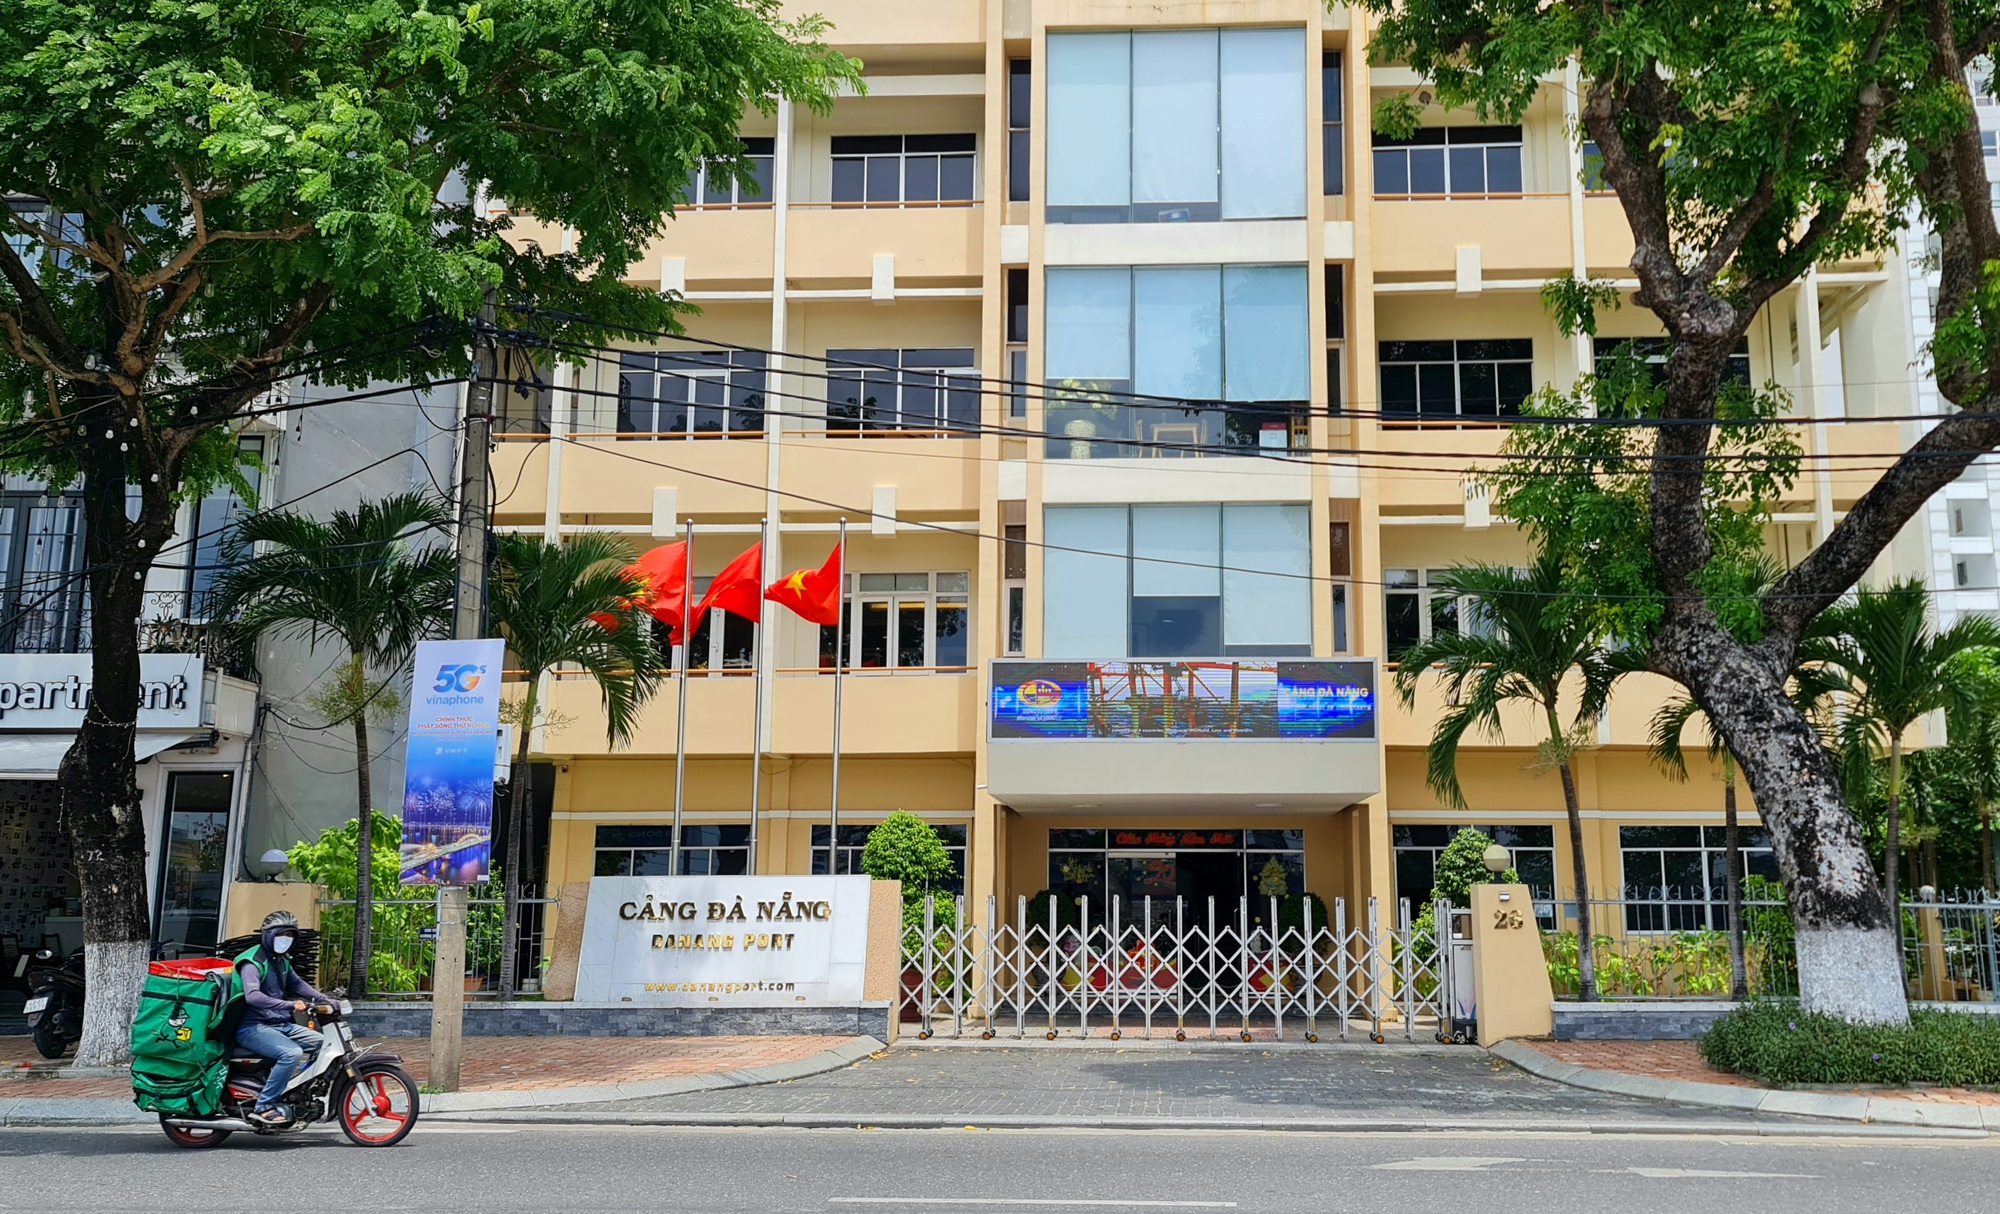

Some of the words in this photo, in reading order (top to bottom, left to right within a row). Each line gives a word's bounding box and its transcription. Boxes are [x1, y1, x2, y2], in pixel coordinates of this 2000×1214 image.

[0, 675, 186, 720] partnt
[426, 695, 484, 706] vinaphone
[618, 894, 697, 922] CẢNG
[706, 896, 747, 922] ĐÀ
[756, 892, 832, 921] NẴNG
[1493, 909, 1524, 930] 26
[651, 934, 735, 950] DANANG
[743, 933, 795, 950] PORT
[644, 980, 795, 994] www.danangport.com
